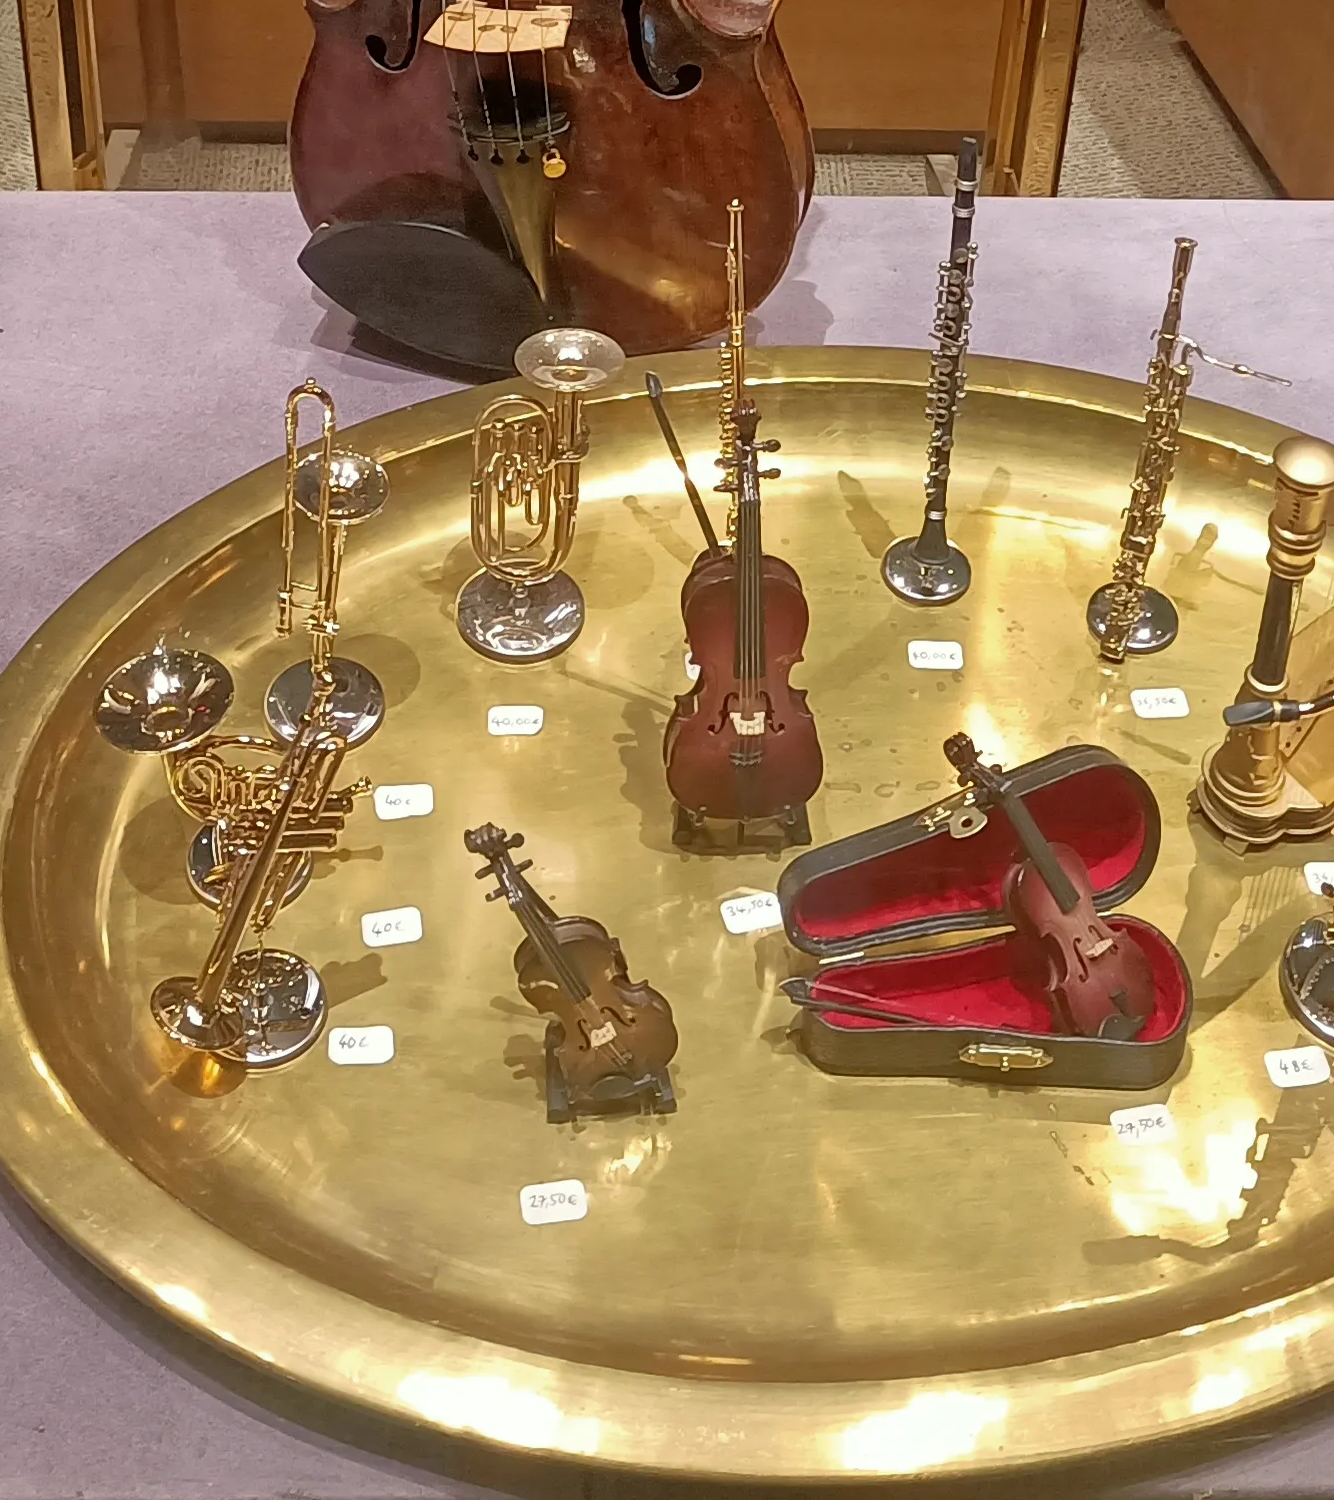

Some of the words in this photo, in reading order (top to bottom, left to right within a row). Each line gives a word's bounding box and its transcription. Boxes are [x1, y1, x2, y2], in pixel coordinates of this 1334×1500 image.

[726, 898, 773, 916] 34,50€
[1117, 1116, 1167, 1139] 27,50€
[528, 1192, 578, 1209] 27,50€
